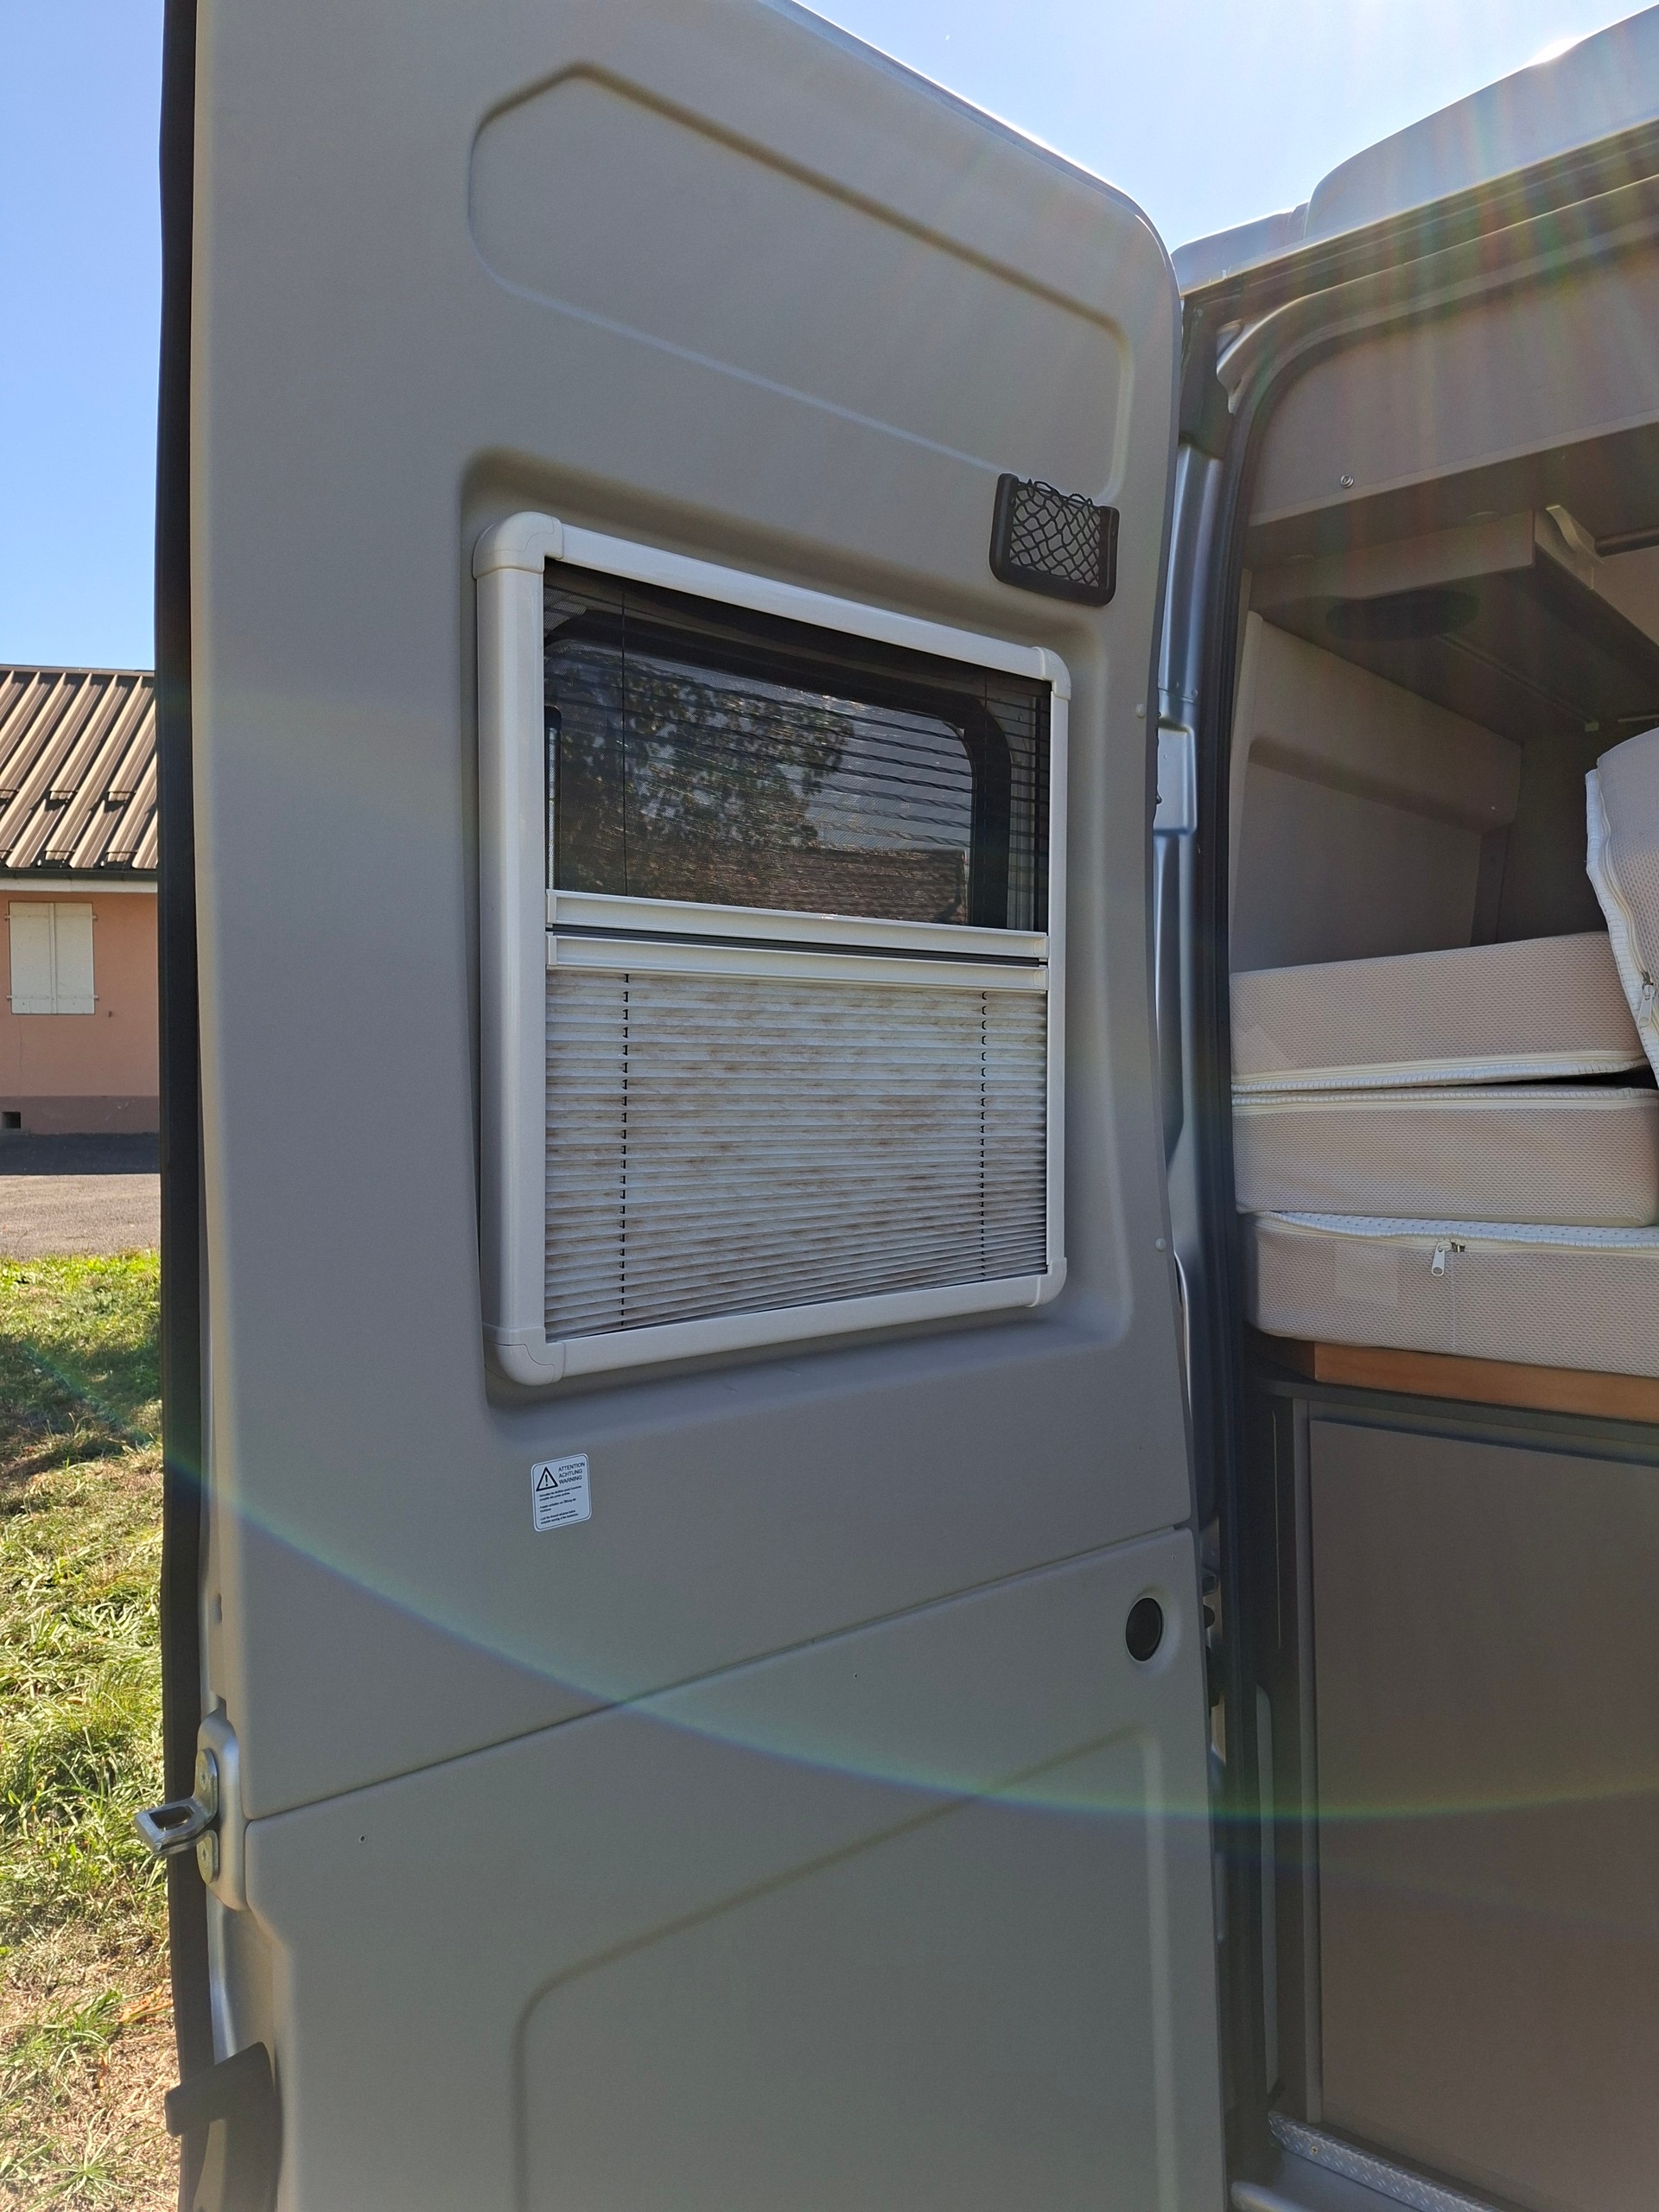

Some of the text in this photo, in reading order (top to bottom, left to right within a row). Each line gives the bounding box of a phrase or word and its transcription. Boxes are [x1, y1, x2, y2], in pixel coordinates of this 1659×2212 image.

[558, 1462, 585, 1472] ATTENTION
[558, 1469, 583, 1478] ACHTUNG
[559, 1475, 582, 1484] WARNING
